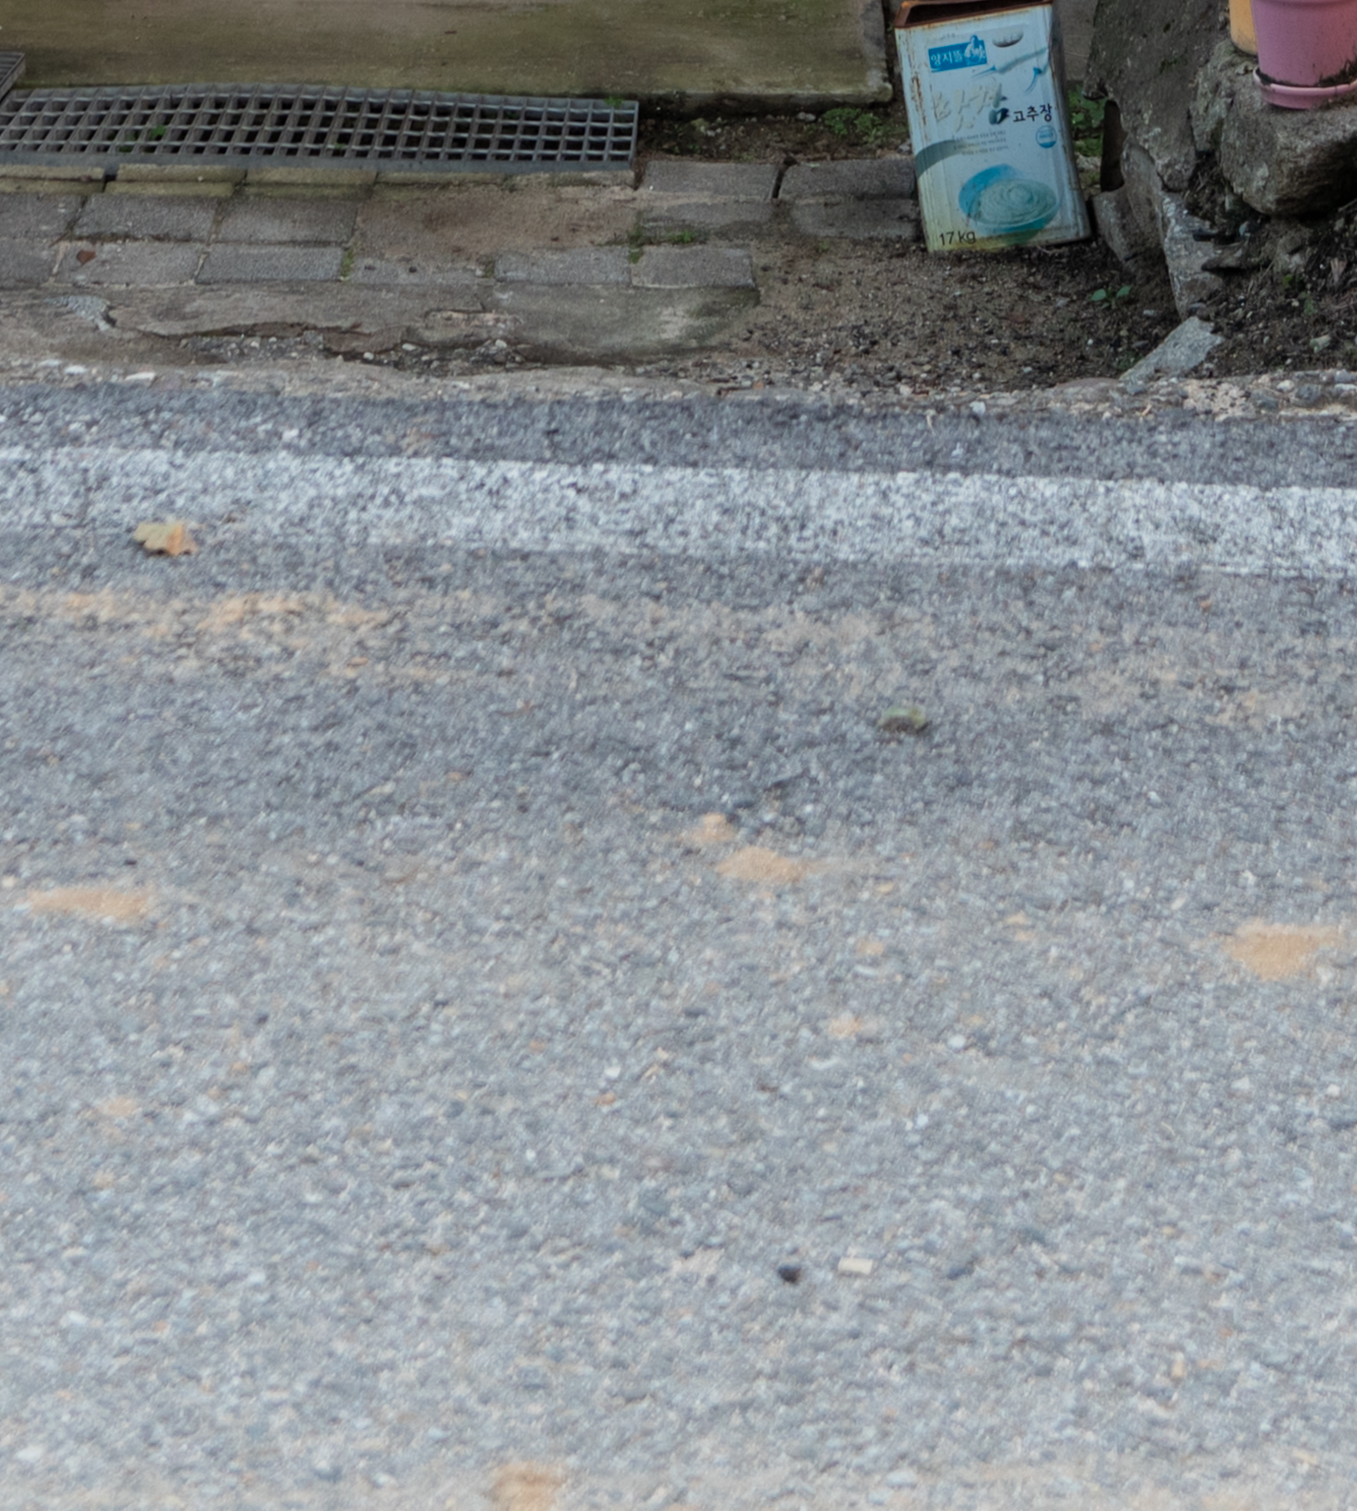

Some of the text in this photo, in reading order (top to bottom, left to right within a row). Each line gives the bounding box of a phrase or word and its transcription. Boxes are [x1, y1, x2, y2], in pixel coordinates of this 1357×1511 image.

[1012, 103, 1053, 123] 고추장
[939, 230, 976, 246] 17 kg
